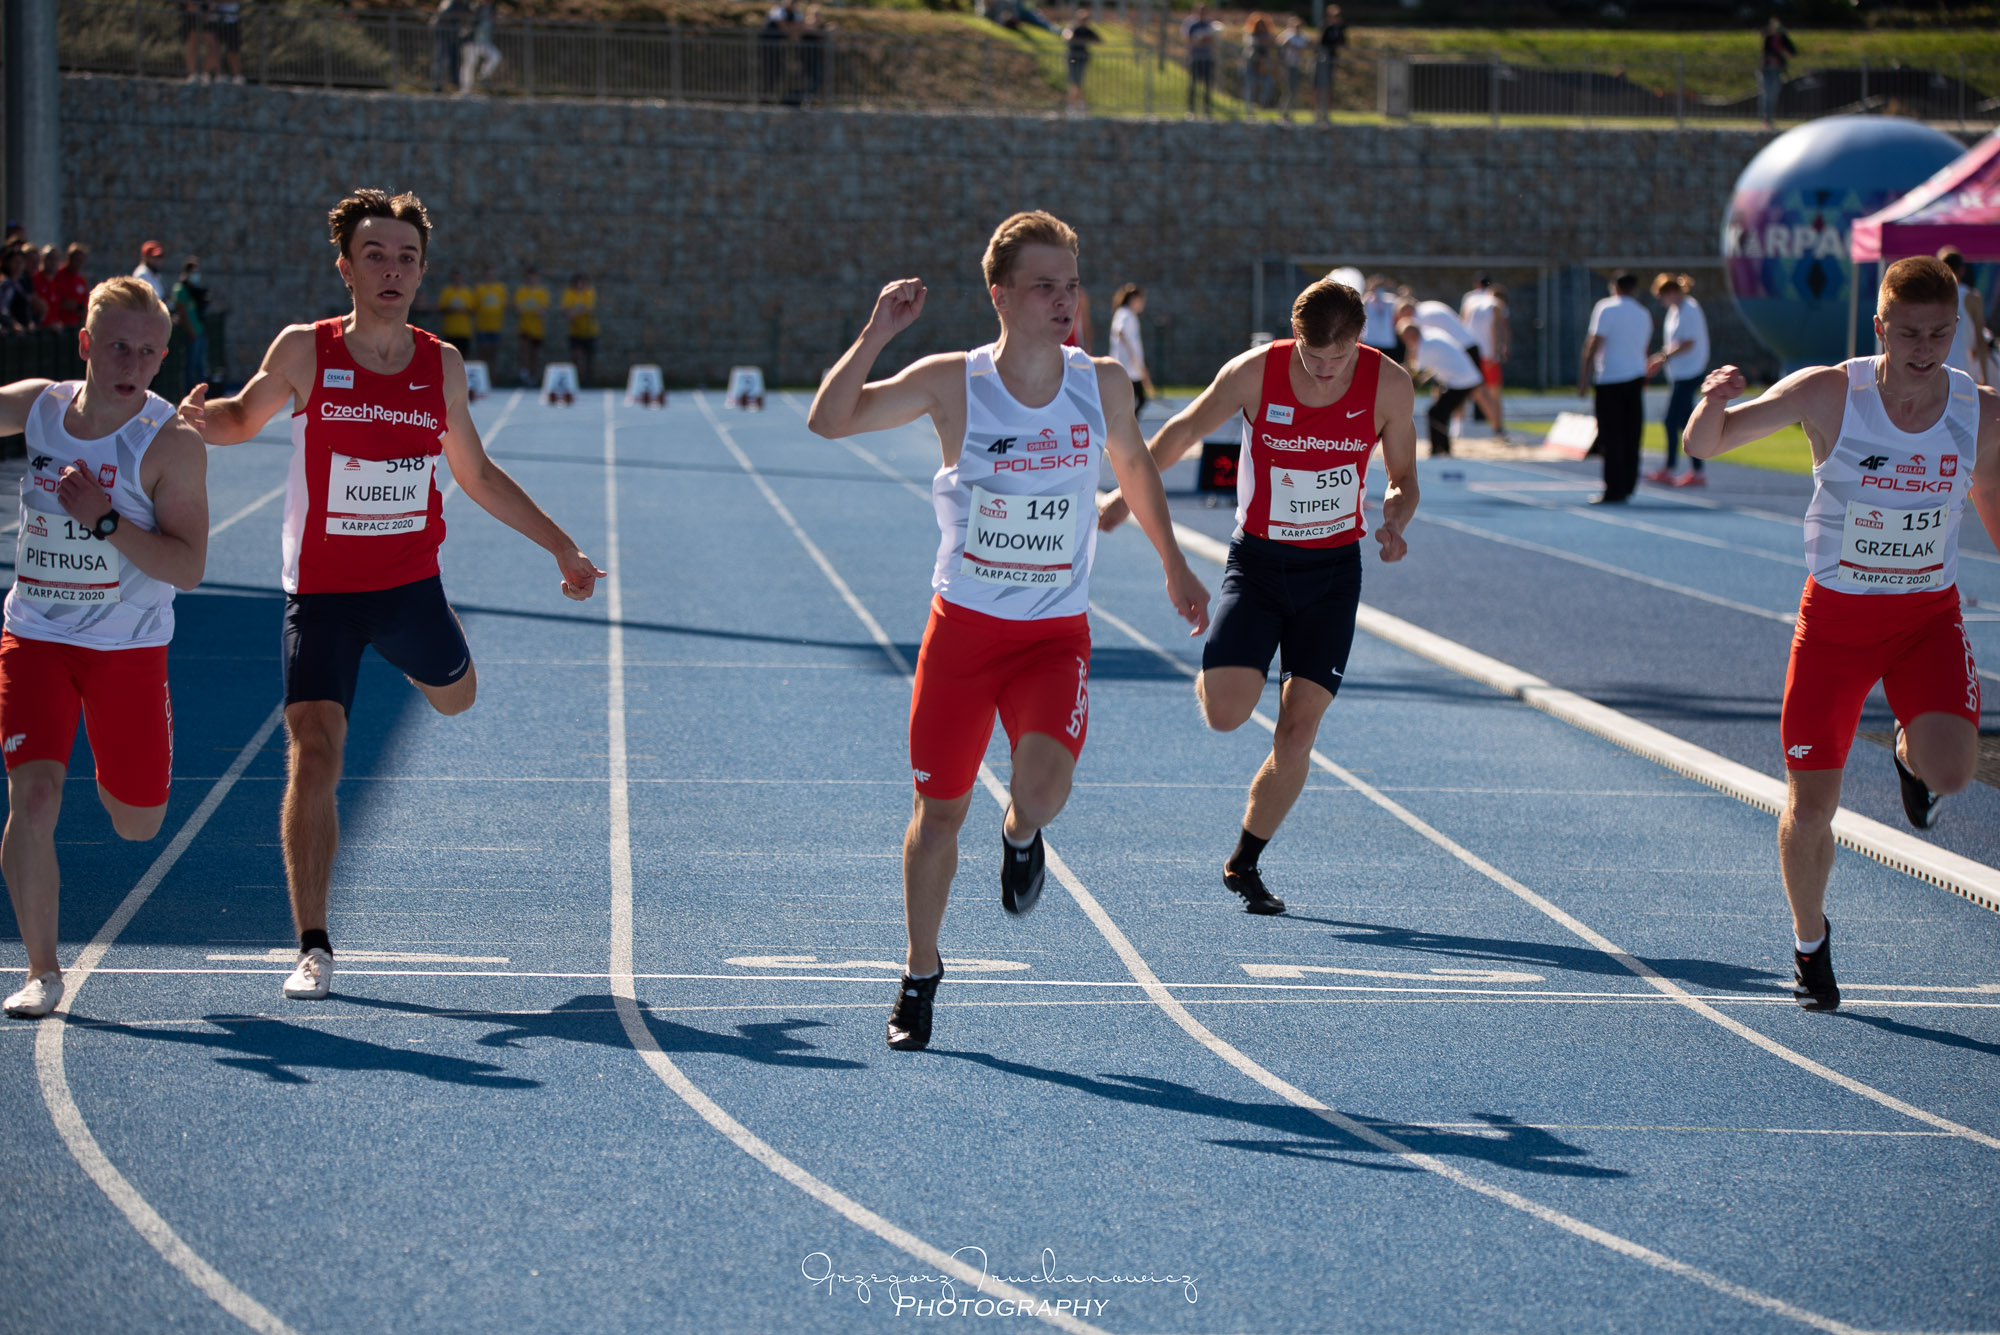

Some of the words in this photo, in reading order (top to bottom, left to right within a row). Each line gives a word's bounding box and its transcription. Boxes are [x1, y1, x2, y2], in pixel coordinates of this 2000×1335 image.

[1727, 224, 1852, 260] KARPA
[321, 402, 438, 430] CzechRepublic
[987, 437, 1018, 455] 4F
[1027, 441, 1057, 452] ORLEN
[1262, 434, 1368, 452] CzechRepublic
[31, 455, 52, 471] 4F
[386, 457, 425, 473] 548
[994, 454, 1088, 473] POLSKA
[1858, 455, 1889, 471] 4F
[1896, 465, 1926, 475] ORLEN
[1316, 468, 1352, 490] 550
[1861, 475, 1953, 493] POLSKA
[345, 485, 417, 501] KUBELIK
[980, 506, 1007, 519] ORLEN
[1026, 499, 1069, 521] 149
[1289, 497, 1340, 514] STIPEK
[342, 521, 390, 531] KARPACZ
[392, 519, 414, 530] 2020
[1855, 518, 1883, 530] ORLEN
[1902, 510, 1941, 531] 151
[27, 524, 48, 537] ORLEN
[64, 520, 93, 541] 15
[1281, 527, 1324, 538] KARPACZ
[1326, 522, 1346, 534] 2020
[977, 528, 1064, 551] WDOWIK
[1855, 539, 1936, 558] GRZELAK
[26, 548, 108, 571] PIETRUSA
[975, 566, 1028, 582] KARPACZ
[1030, 573, 1056, 583] 2020
[1852, 571, 1904, 585] KARPACZ
[1906, 574, 1931, 585] 2020
[27, 586, 76, 600] KARPACZ
[79, 591, 105, 601] 2020
[1787, 744, 1813, 759] 4F
